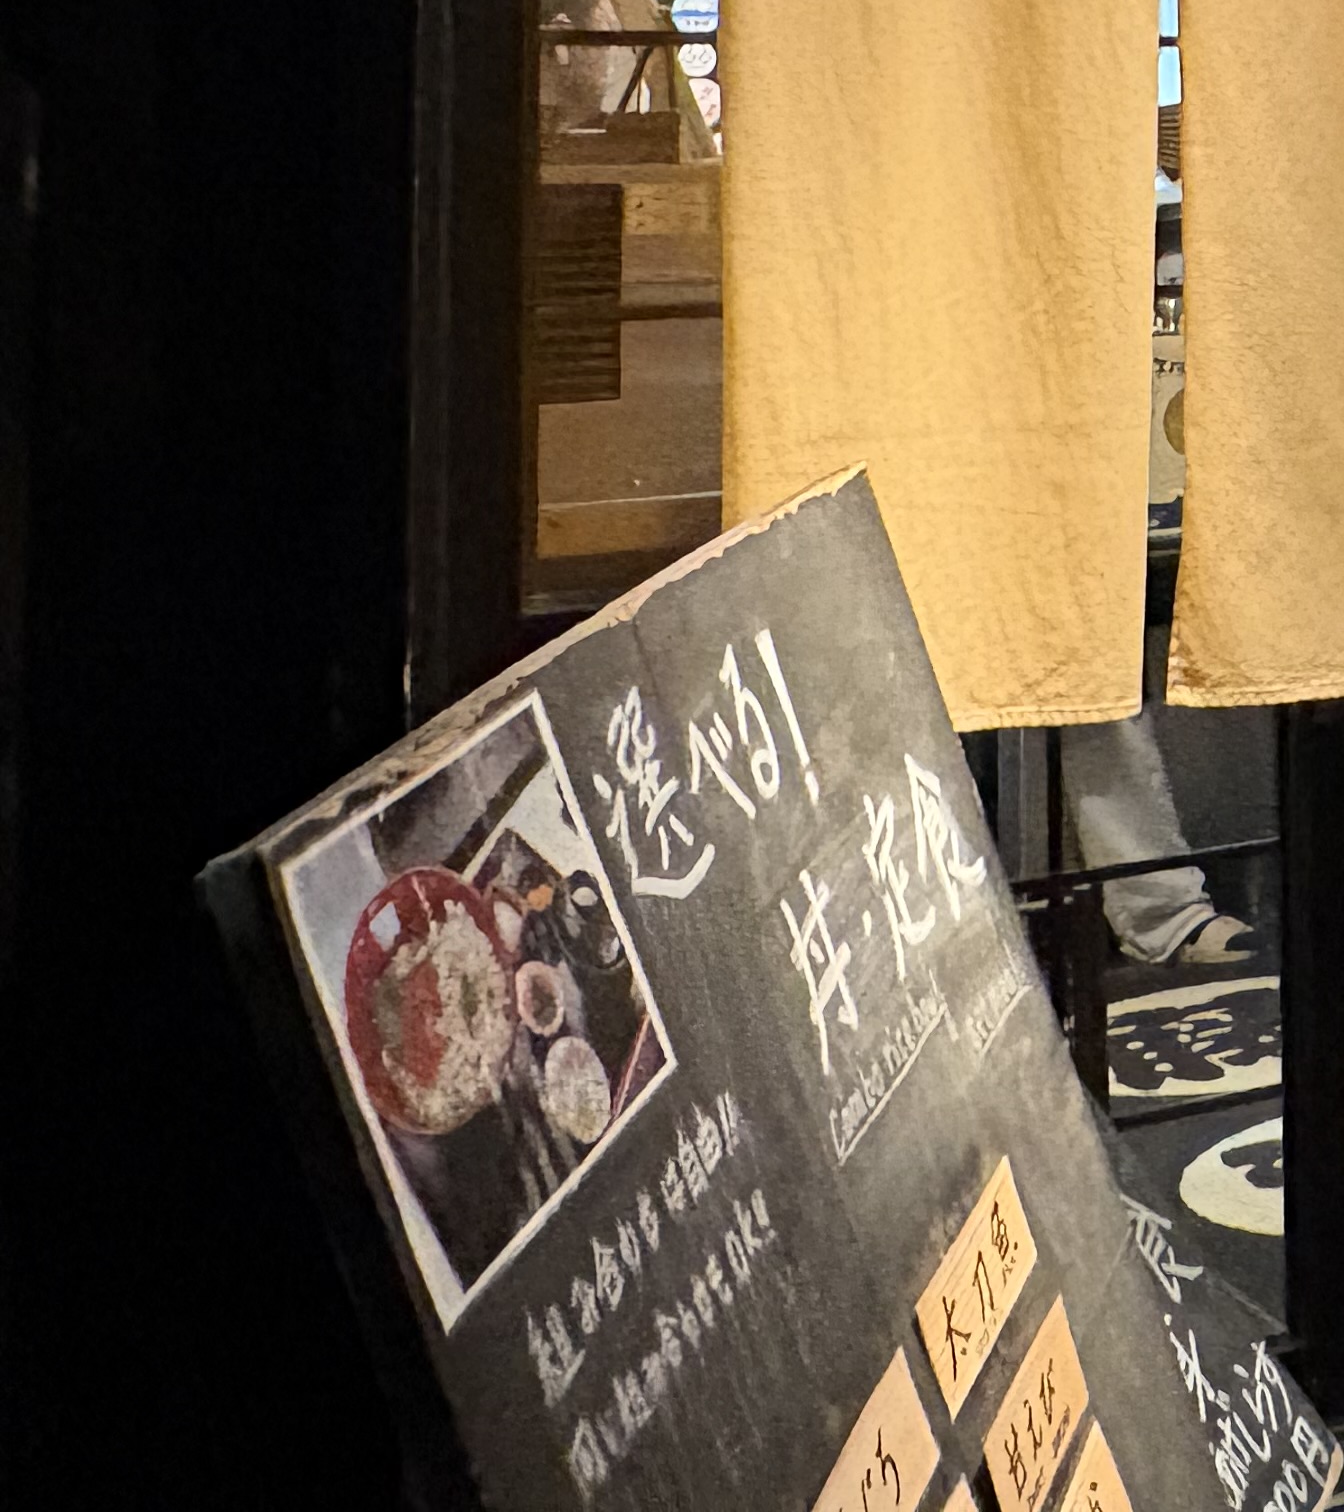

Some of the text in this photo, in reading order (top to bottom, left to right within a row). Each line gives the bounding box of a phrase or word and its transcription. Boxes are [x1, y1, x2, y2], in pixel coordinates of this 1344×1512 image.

[594, 628, 821, 899] 選べる!
[942, 1201, 1018, 1382] 太刀魚
